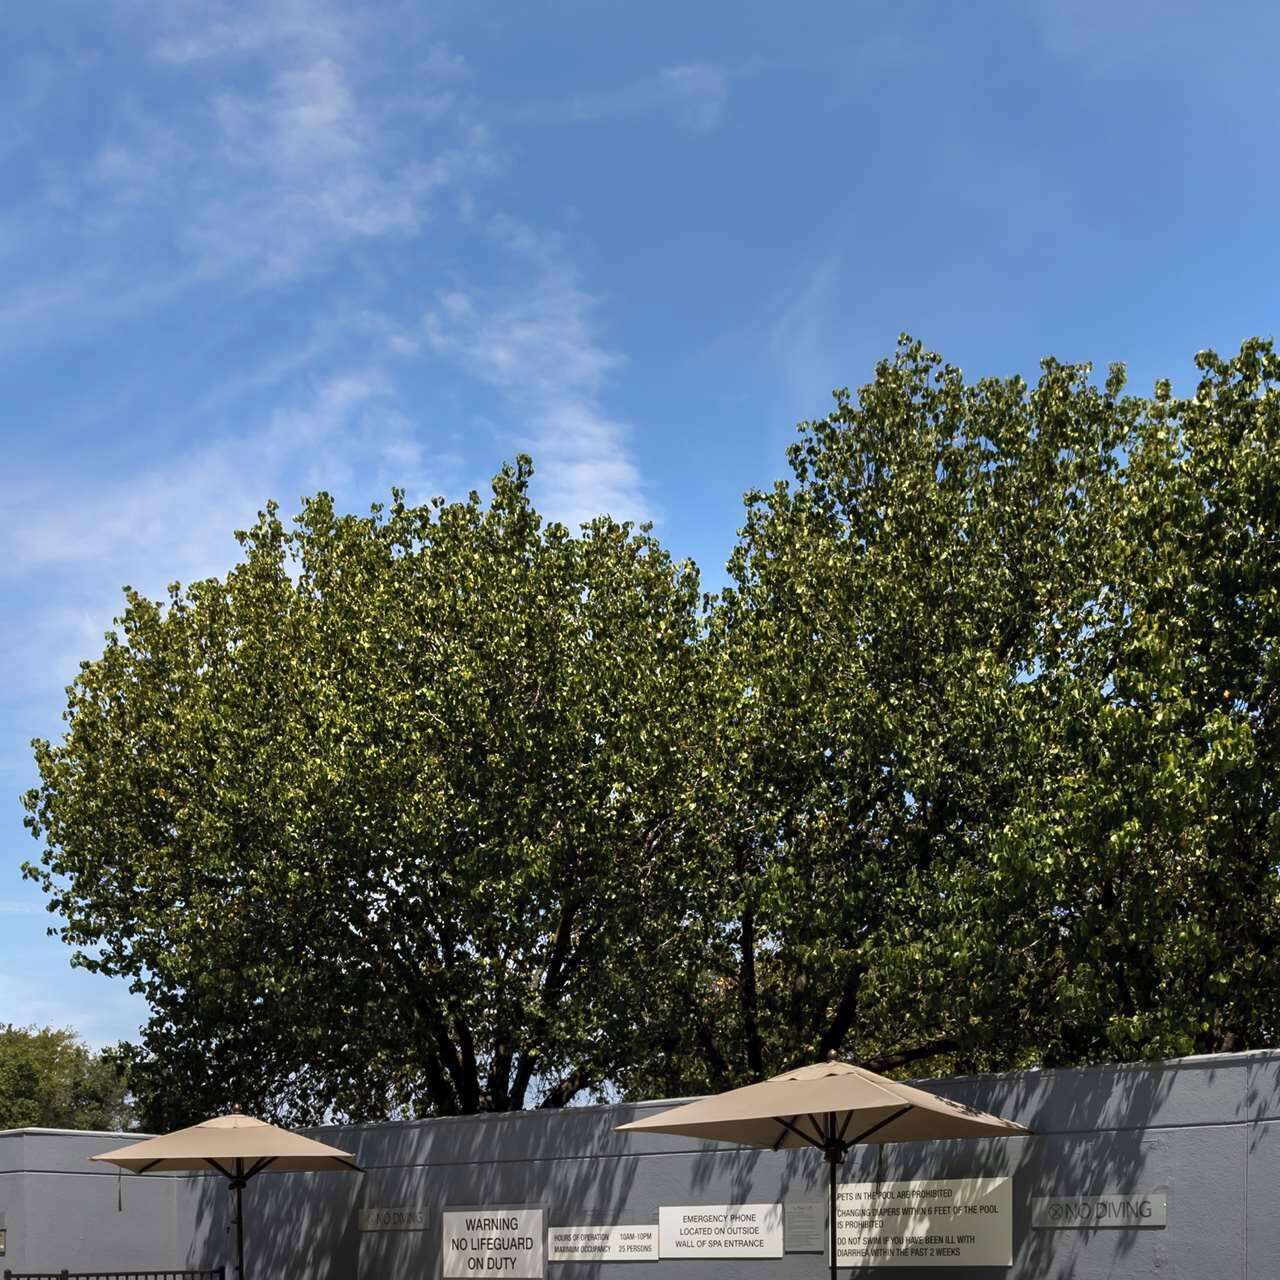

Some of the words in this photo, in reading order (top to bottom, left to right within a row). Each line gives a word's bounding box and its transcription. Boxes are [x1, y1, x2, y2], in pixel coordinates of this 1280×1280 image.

[837, 1192, 854, 1200] PETS
[864, 1192, 877, 1200] THE
[878, 1191, 895, 1199] POOL
[897, 1190, 910, 1199] ARE
[912, 1189, 953, 1198] PROHIBITED
[837, 1208, 871, 1217] CHANGING
[872, 1208, 900, 1216] DIAPERS
[902, 1207, 926, 1216] WITHIN
[927, 1206, 933, 1215] 6
[934, 1206, 951, 1215] FEET
[953, 1206, 962, 1215] OF
[964, 1205, 977, 1214] THE
[980, 1205, 999, 1214] POOL
[1065, 1203, 1092, 1219] NO
[1095, 1201, 1152, 1219] DIVING
[683, 1215, 728, 1223] EMERGENCY
[730, 1214, 757, 1222] PHONE
[465, 1217, 519, 1231] WARNING
[837, 1221, 843, 1229] IS
[845, 1220, 884, 1229] PROHIBITED
[680, 1227, 712, 1236] LOCATED
[714, 1227, 725, 1235] ON
[727, 1226, 760, 1235] OUTSIDE
[580, 1233, 610, 1241] OPERATION
[620, 1232, 652, 1241] 10AM-10PM
[837, 1237, 847, 1245] DO
[848, 1237, 861, 1245] NOT
[863, 1236, 881, 1245] SWIM
[883, 1236, 889, 1245] IF
[891, 1236, 904, 1245] YOU
[905, 1236, 924, 1245] HAVE
[925, 1235, 944, 1245] BEEN
[945, 1235, 956, 1244] ILL
[957, 1234, 976, 1244] WITH
[452, 1238, 468, 1251] NO
[471, 1237, 534, 1251] LIFEGUARD
[619, 1245, 626, 1253] 25
[627, 1244, 652, 1252] PERSONS
[675, 1240, 695, 1248] WALL
[696, 1240, 707, 1248] OF
[708, 1240, 722, 1248] SPA
[724, 1239, 764, 1248] ENTRANCE
[837, 1249, 870, 1257] DIARRHEA
[871, 1248, 895, 1257] WITHIN
[896, 1248, 909, 1257] THE
[910, 1248, 928, 1257] PAST
[929, 1248, 935, 1257] 2
[936, 1247, 961, 1257] WEEKS
[467, 1257, 484, 1270] ON
[488, 1257, 517, 1270] DUTY
